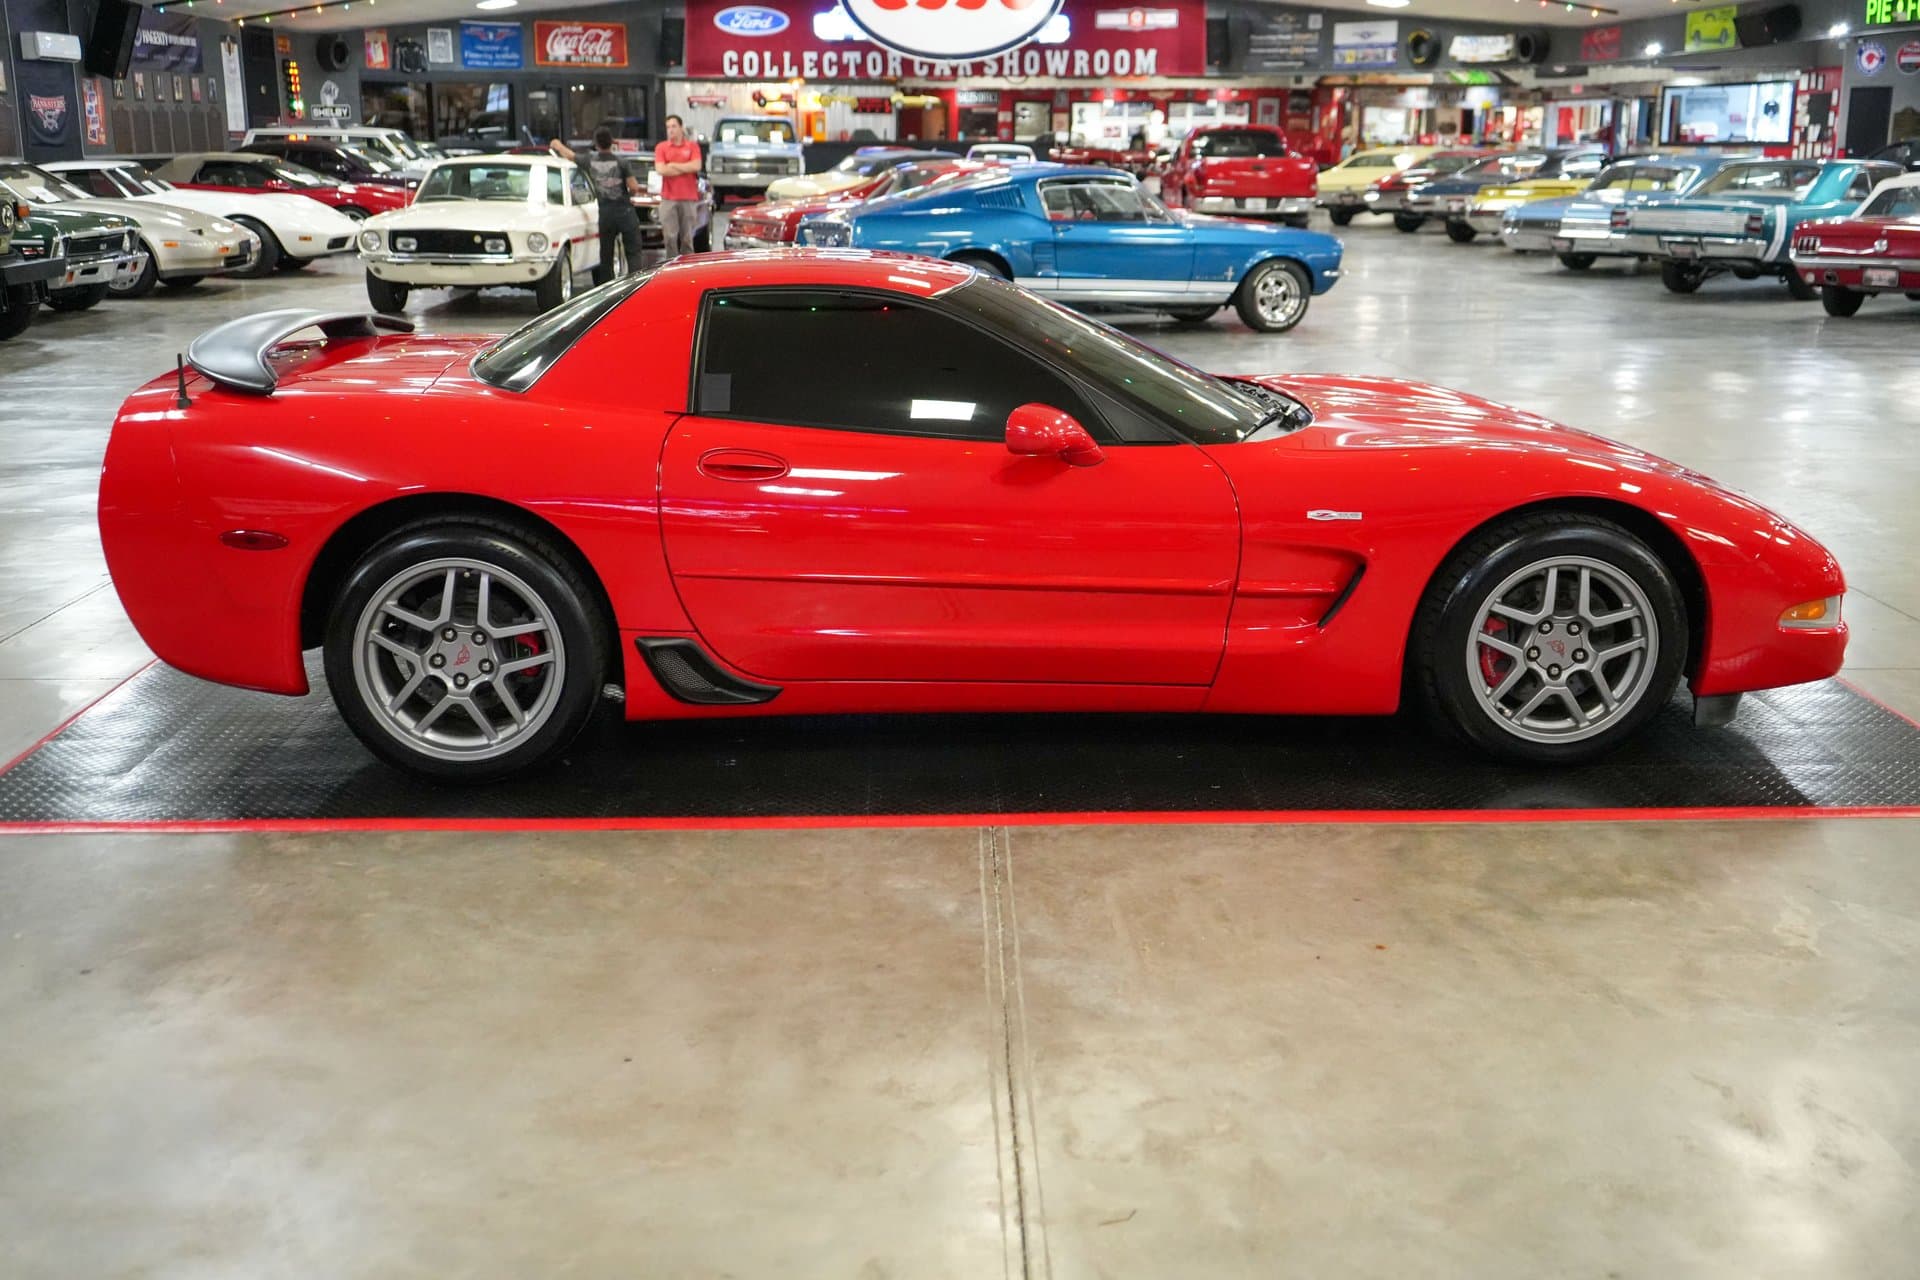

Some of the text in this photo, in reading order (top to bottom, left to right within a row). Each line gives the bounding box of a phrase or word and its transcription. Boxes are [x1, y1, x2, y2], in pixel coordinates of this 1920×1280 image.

[730, 9, 773, 28] Ford
[1866, 0, 1891, 24] PIE
[141, 30, 169, 46] HAGERTY
[546, 28, 616, 56] Coca-Cola
[723, 50, 902, 78] COLLECTOR
[983, 49, 1157, 76] SHOWROOM
[313, 108, 348, 117] SHELBY
